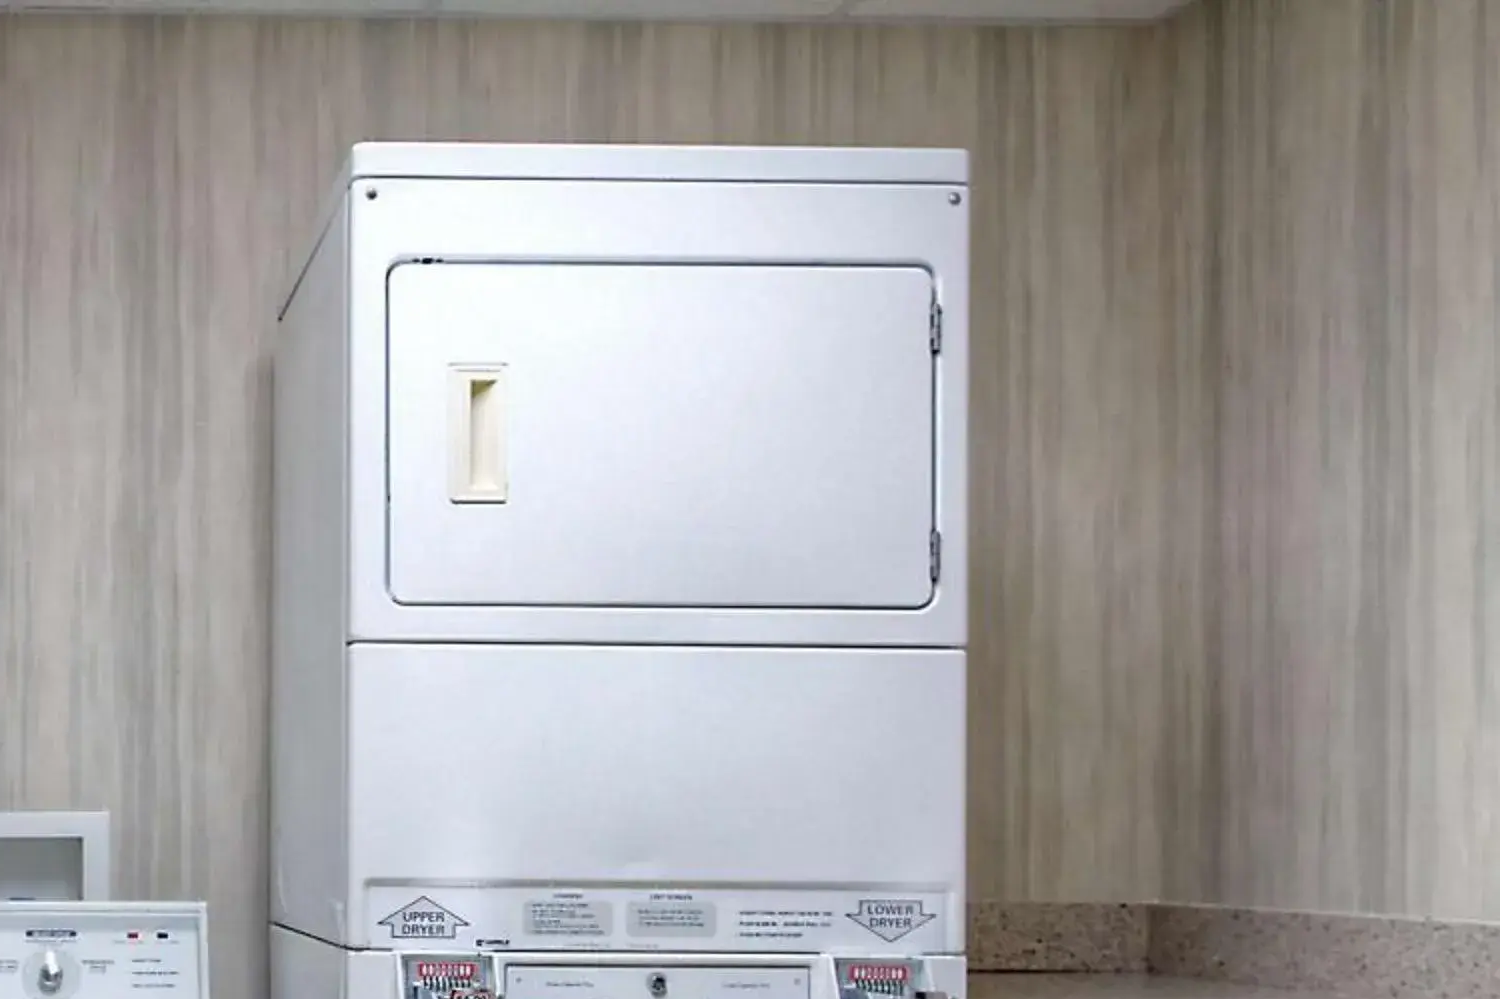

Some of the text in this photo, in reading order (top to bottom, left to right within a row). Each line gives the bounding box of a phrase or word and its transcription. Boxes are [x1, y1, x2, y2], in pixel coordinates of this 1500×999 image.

[867, 904, 914, 915] LOWER
[402, 911, 445, 922] UPPER
[869, 917, 912, 929] DRYER
[402, 924, 445, 935] DRYER
